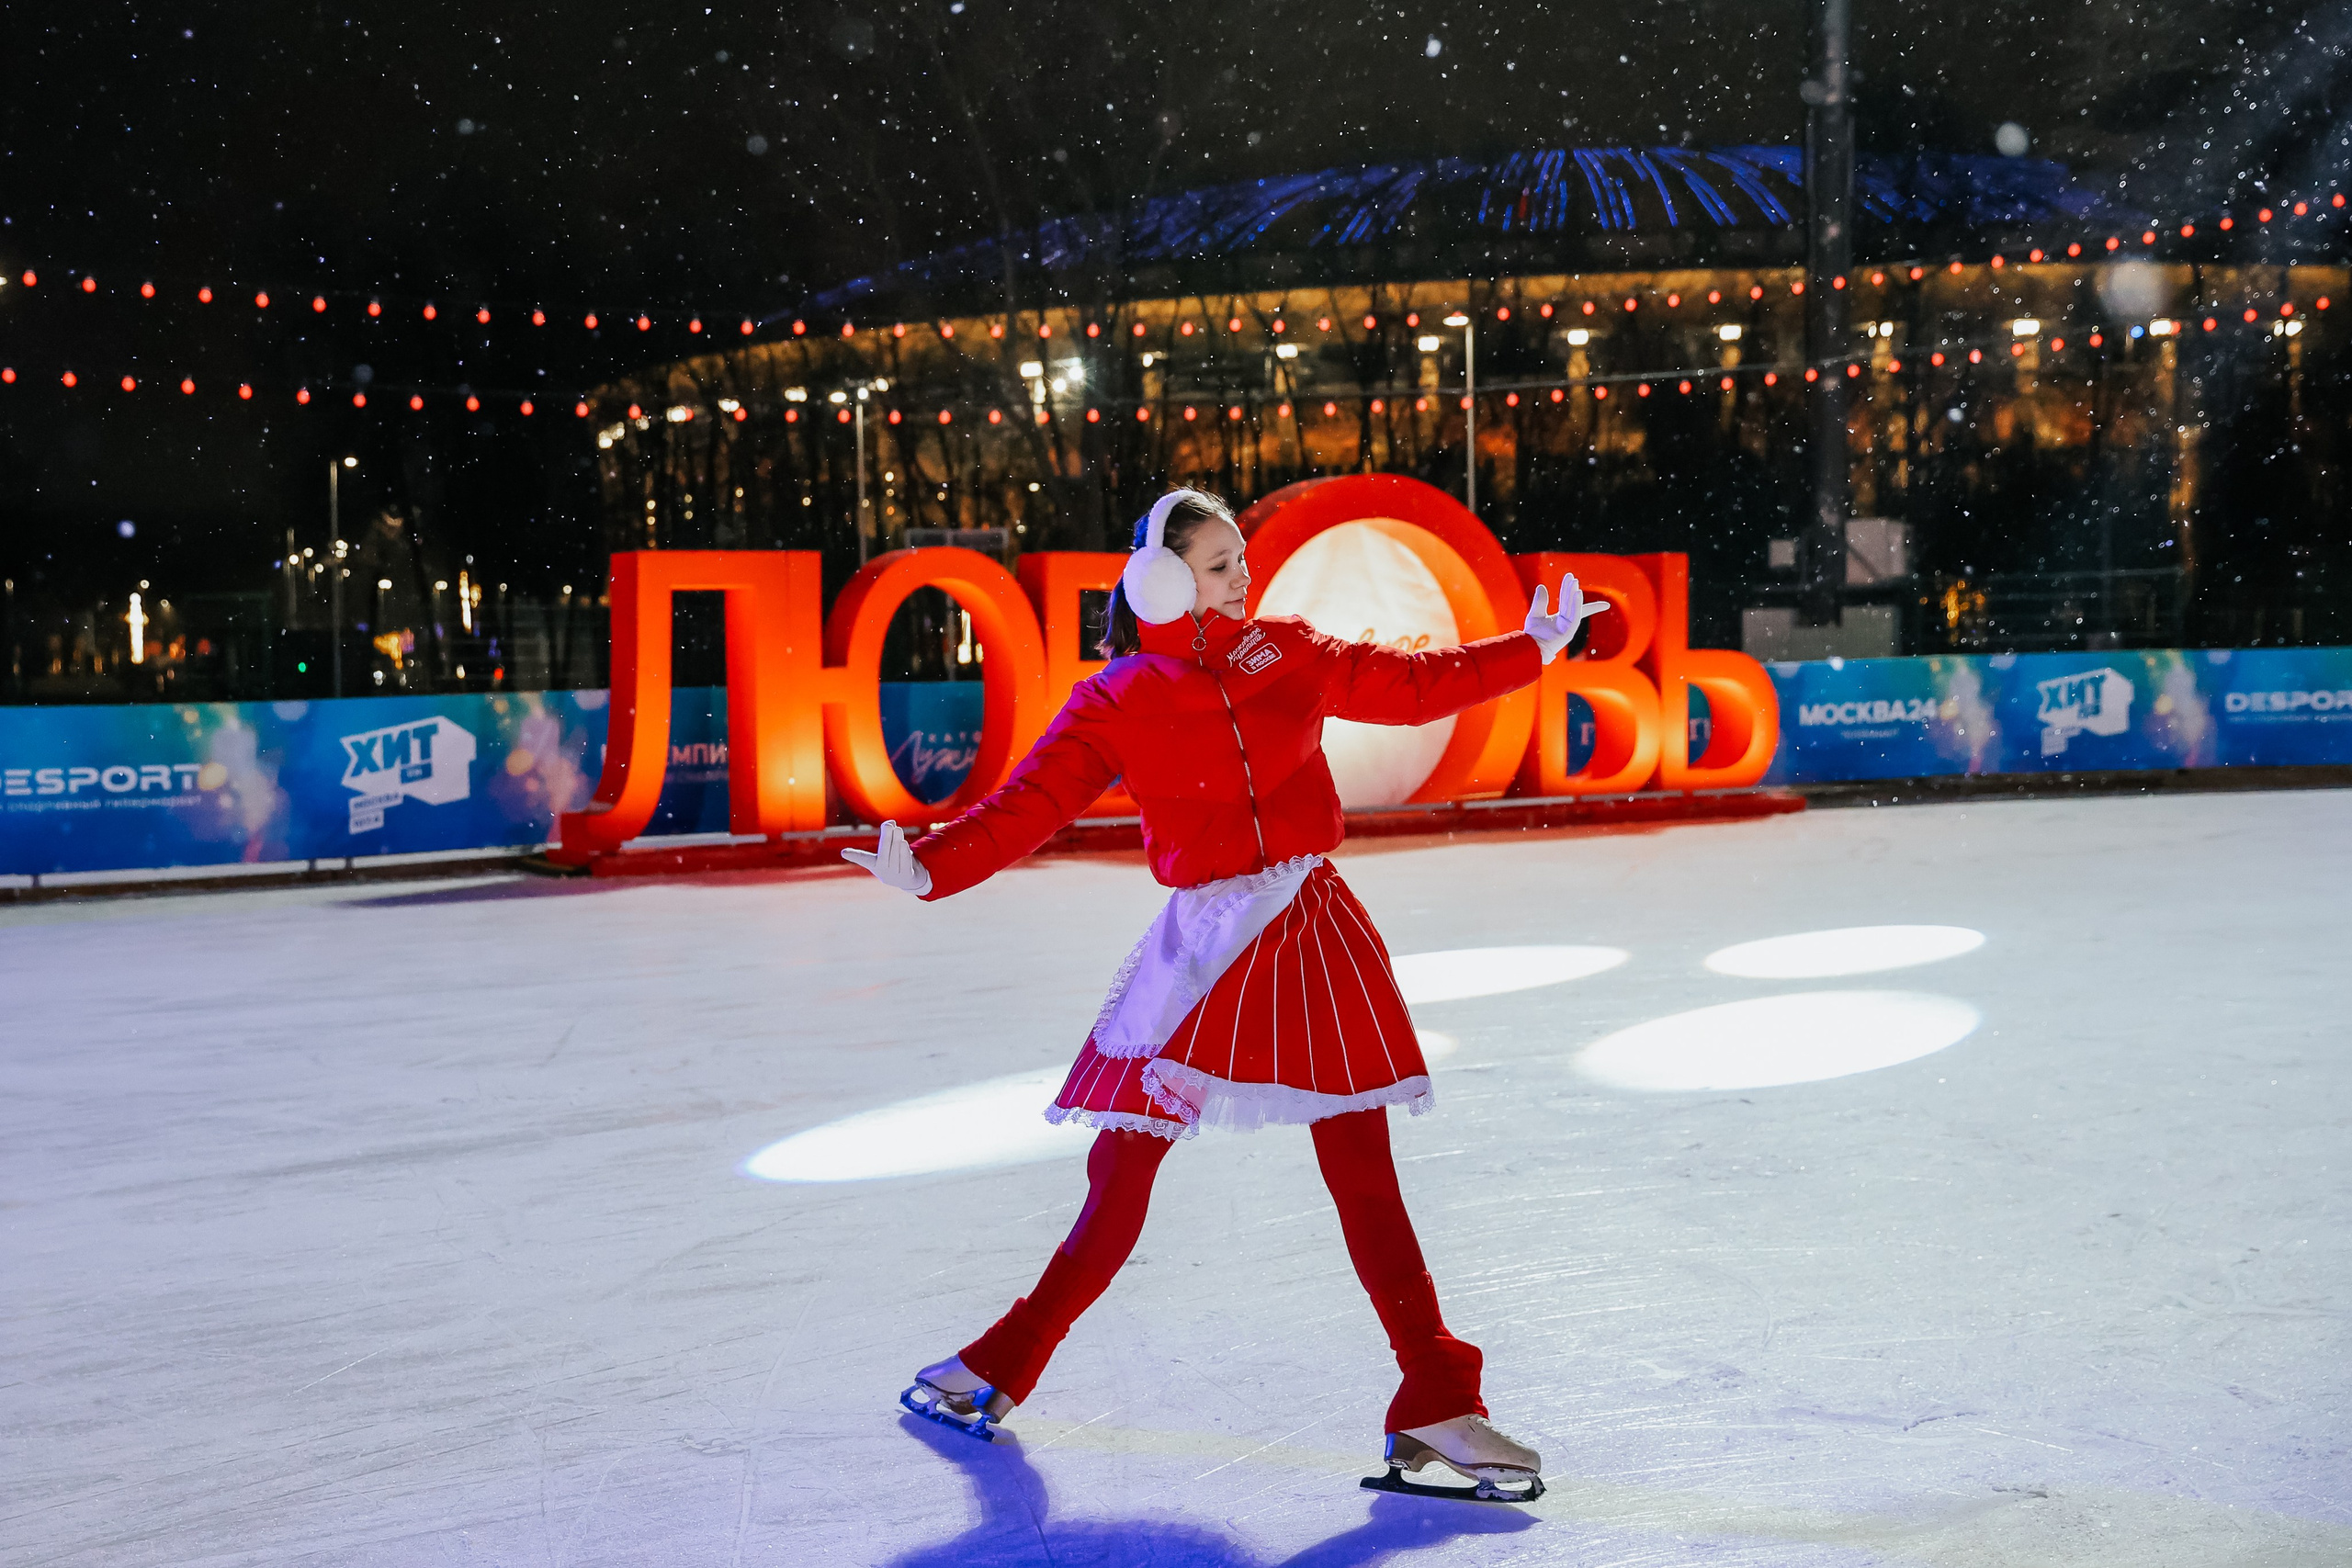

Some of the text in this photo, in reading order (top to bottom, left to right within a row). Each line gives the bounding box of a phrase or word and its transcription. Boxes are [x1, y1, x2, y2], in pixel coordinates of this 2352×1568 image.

[1245, 649, 1273, 667] ЗИМА
[2045, 675, 2106, 713] ХИТ
[350, 724, 439, 778] ХИТ
[0, 763, 201, 796] ESPORT
